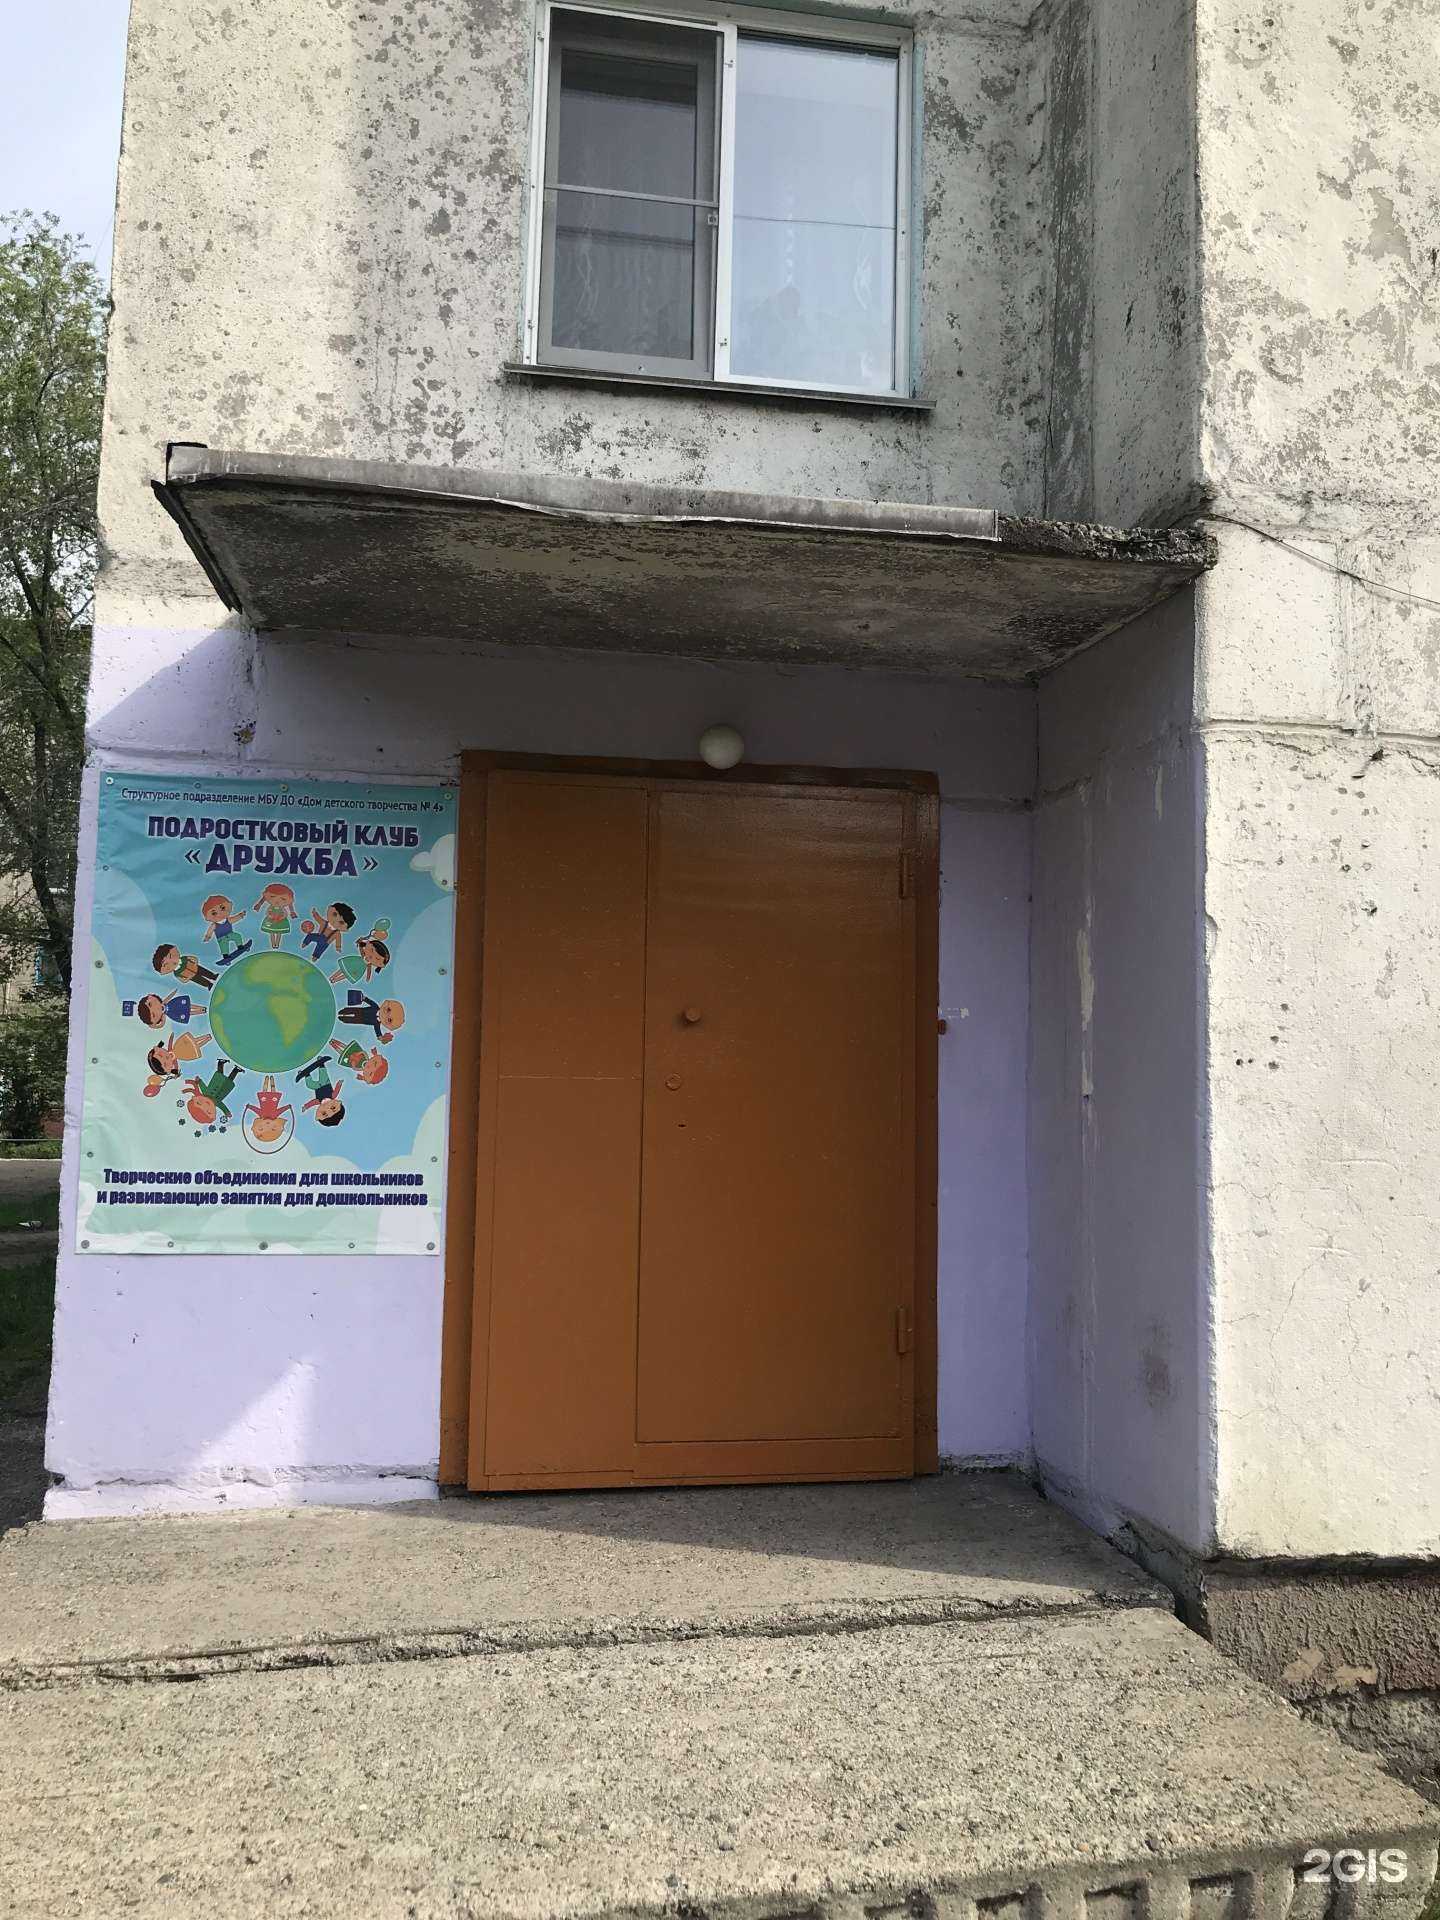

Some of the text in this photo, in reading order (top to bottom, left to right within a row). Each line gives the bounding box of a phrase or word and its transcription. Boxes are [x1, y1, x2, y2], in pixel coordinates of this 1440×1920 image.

[121, 788, 180, 800] Структурное
[183, 792, 254, 804] подразделение
[258, 794, 278, 805] МБУ
[280, 795, 295, 806] ДО
[298, 795, 321, 808] «Дом
[324, 799, 364, 809] детского
[367, 800, 417, 812] творчества
[148, 816, 419, 847] ПОДРОСТКОВЫЙ КЛУБ
[104, 1168, 423, 1187] Творческие объединения для школьников
[97, 1191, 428, 1206] и развивающие занятия для дошкольников
